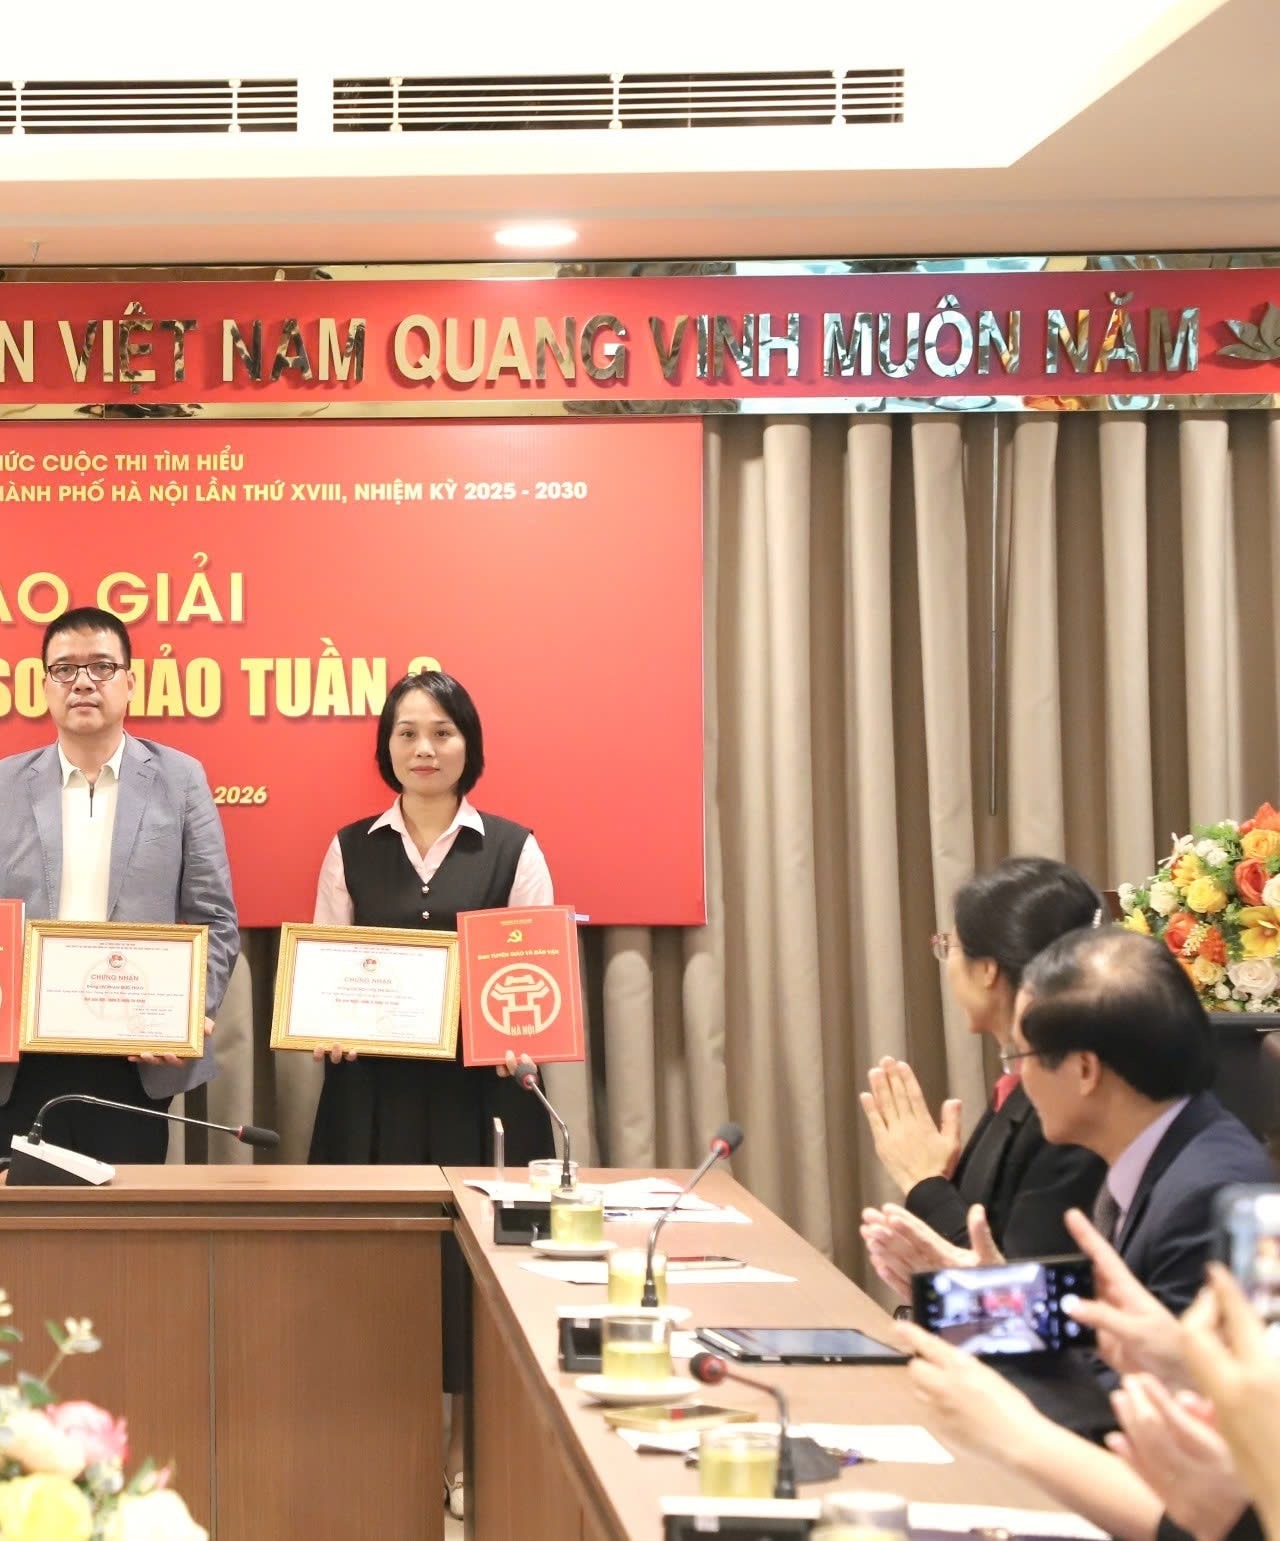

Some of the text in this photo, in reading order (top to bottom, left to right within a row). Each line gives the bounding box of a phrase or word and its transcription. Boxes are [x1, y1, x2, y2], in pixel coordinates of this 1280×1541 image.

[57, 301, 197, 394] VIỆT
[222, 317, 367, 382] NAM
[393, 313, 628, 382] QUANG
[647, 312, 800, 382] VINH
[823, 294, 1022, 379] MUÔN
[1046, 290, 1201, 374] NĂM
[42, 450, 108, 476] CUỘC
[115, 453, 147, 471] THI
[154, 449, 191, 472] TÌM
[197, 445, 244, 472] HIỂU
[57, 474, 104, 502] PHỐ
[112, 479, 143, 501] HÀ
[149, 480, 188, 506] NỘI
[195, 476, 237, 501] LẦN
[242, 478, 285, 501] THỨ
[290, 482, 347, 504] XVIII,
[354, 478, 423, 505] NHIỆM
[430, 477, 458, 500] KỲ
[464, 482, 516, 500] 2025
[535, 481, 588, 499] 2030
[96, 551, 244, 624] GIẢI
[240, 637, 387, 717] TUẦN
[214, 785, 268, 804] 2026
